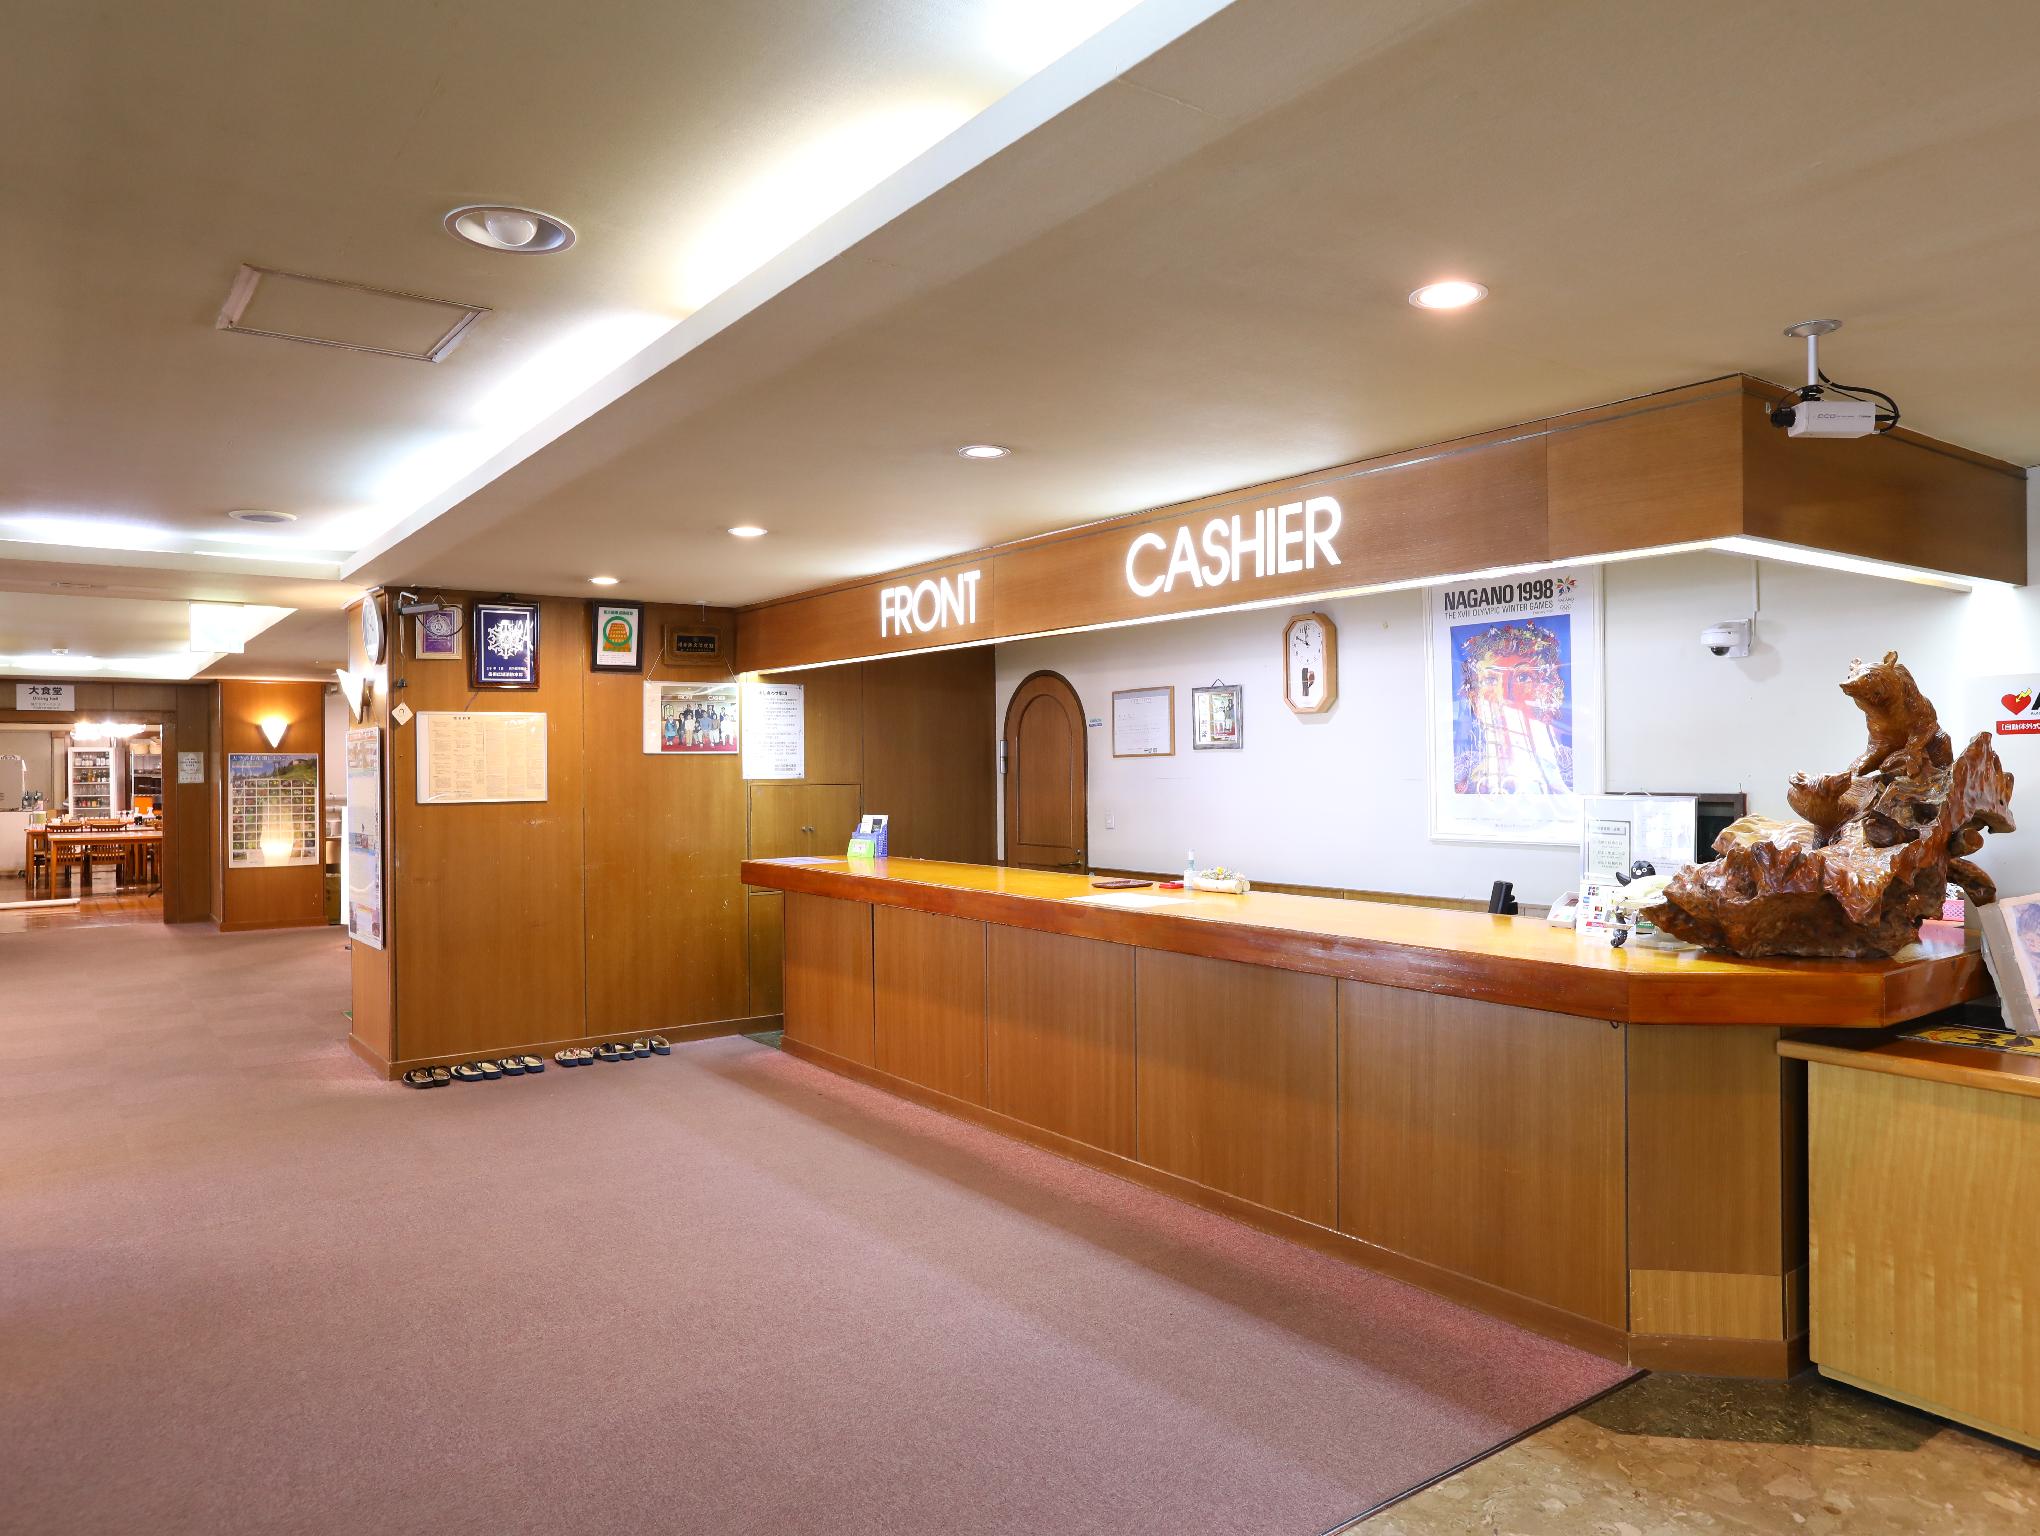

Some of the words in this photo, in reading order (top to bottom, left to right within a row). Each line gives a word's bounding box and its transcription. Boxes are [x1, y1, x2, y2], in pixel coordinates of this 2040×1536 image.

[1125, 495, 1342, 598] CASHIER
[880, 569, 980, 638] FRONT
[1444, 584, 1514, 611] NAGANO
[1516, 578, 1554, 602] 1998
[1445, 612, 1456, 620] THE
[1472, 607, 1501, 617] OLYMPIC
[1502, 603, 1529, 613] WINTER
[1529, 600, 1554, 611] GAMES
[28, 685, 63, 696] 大食堂
